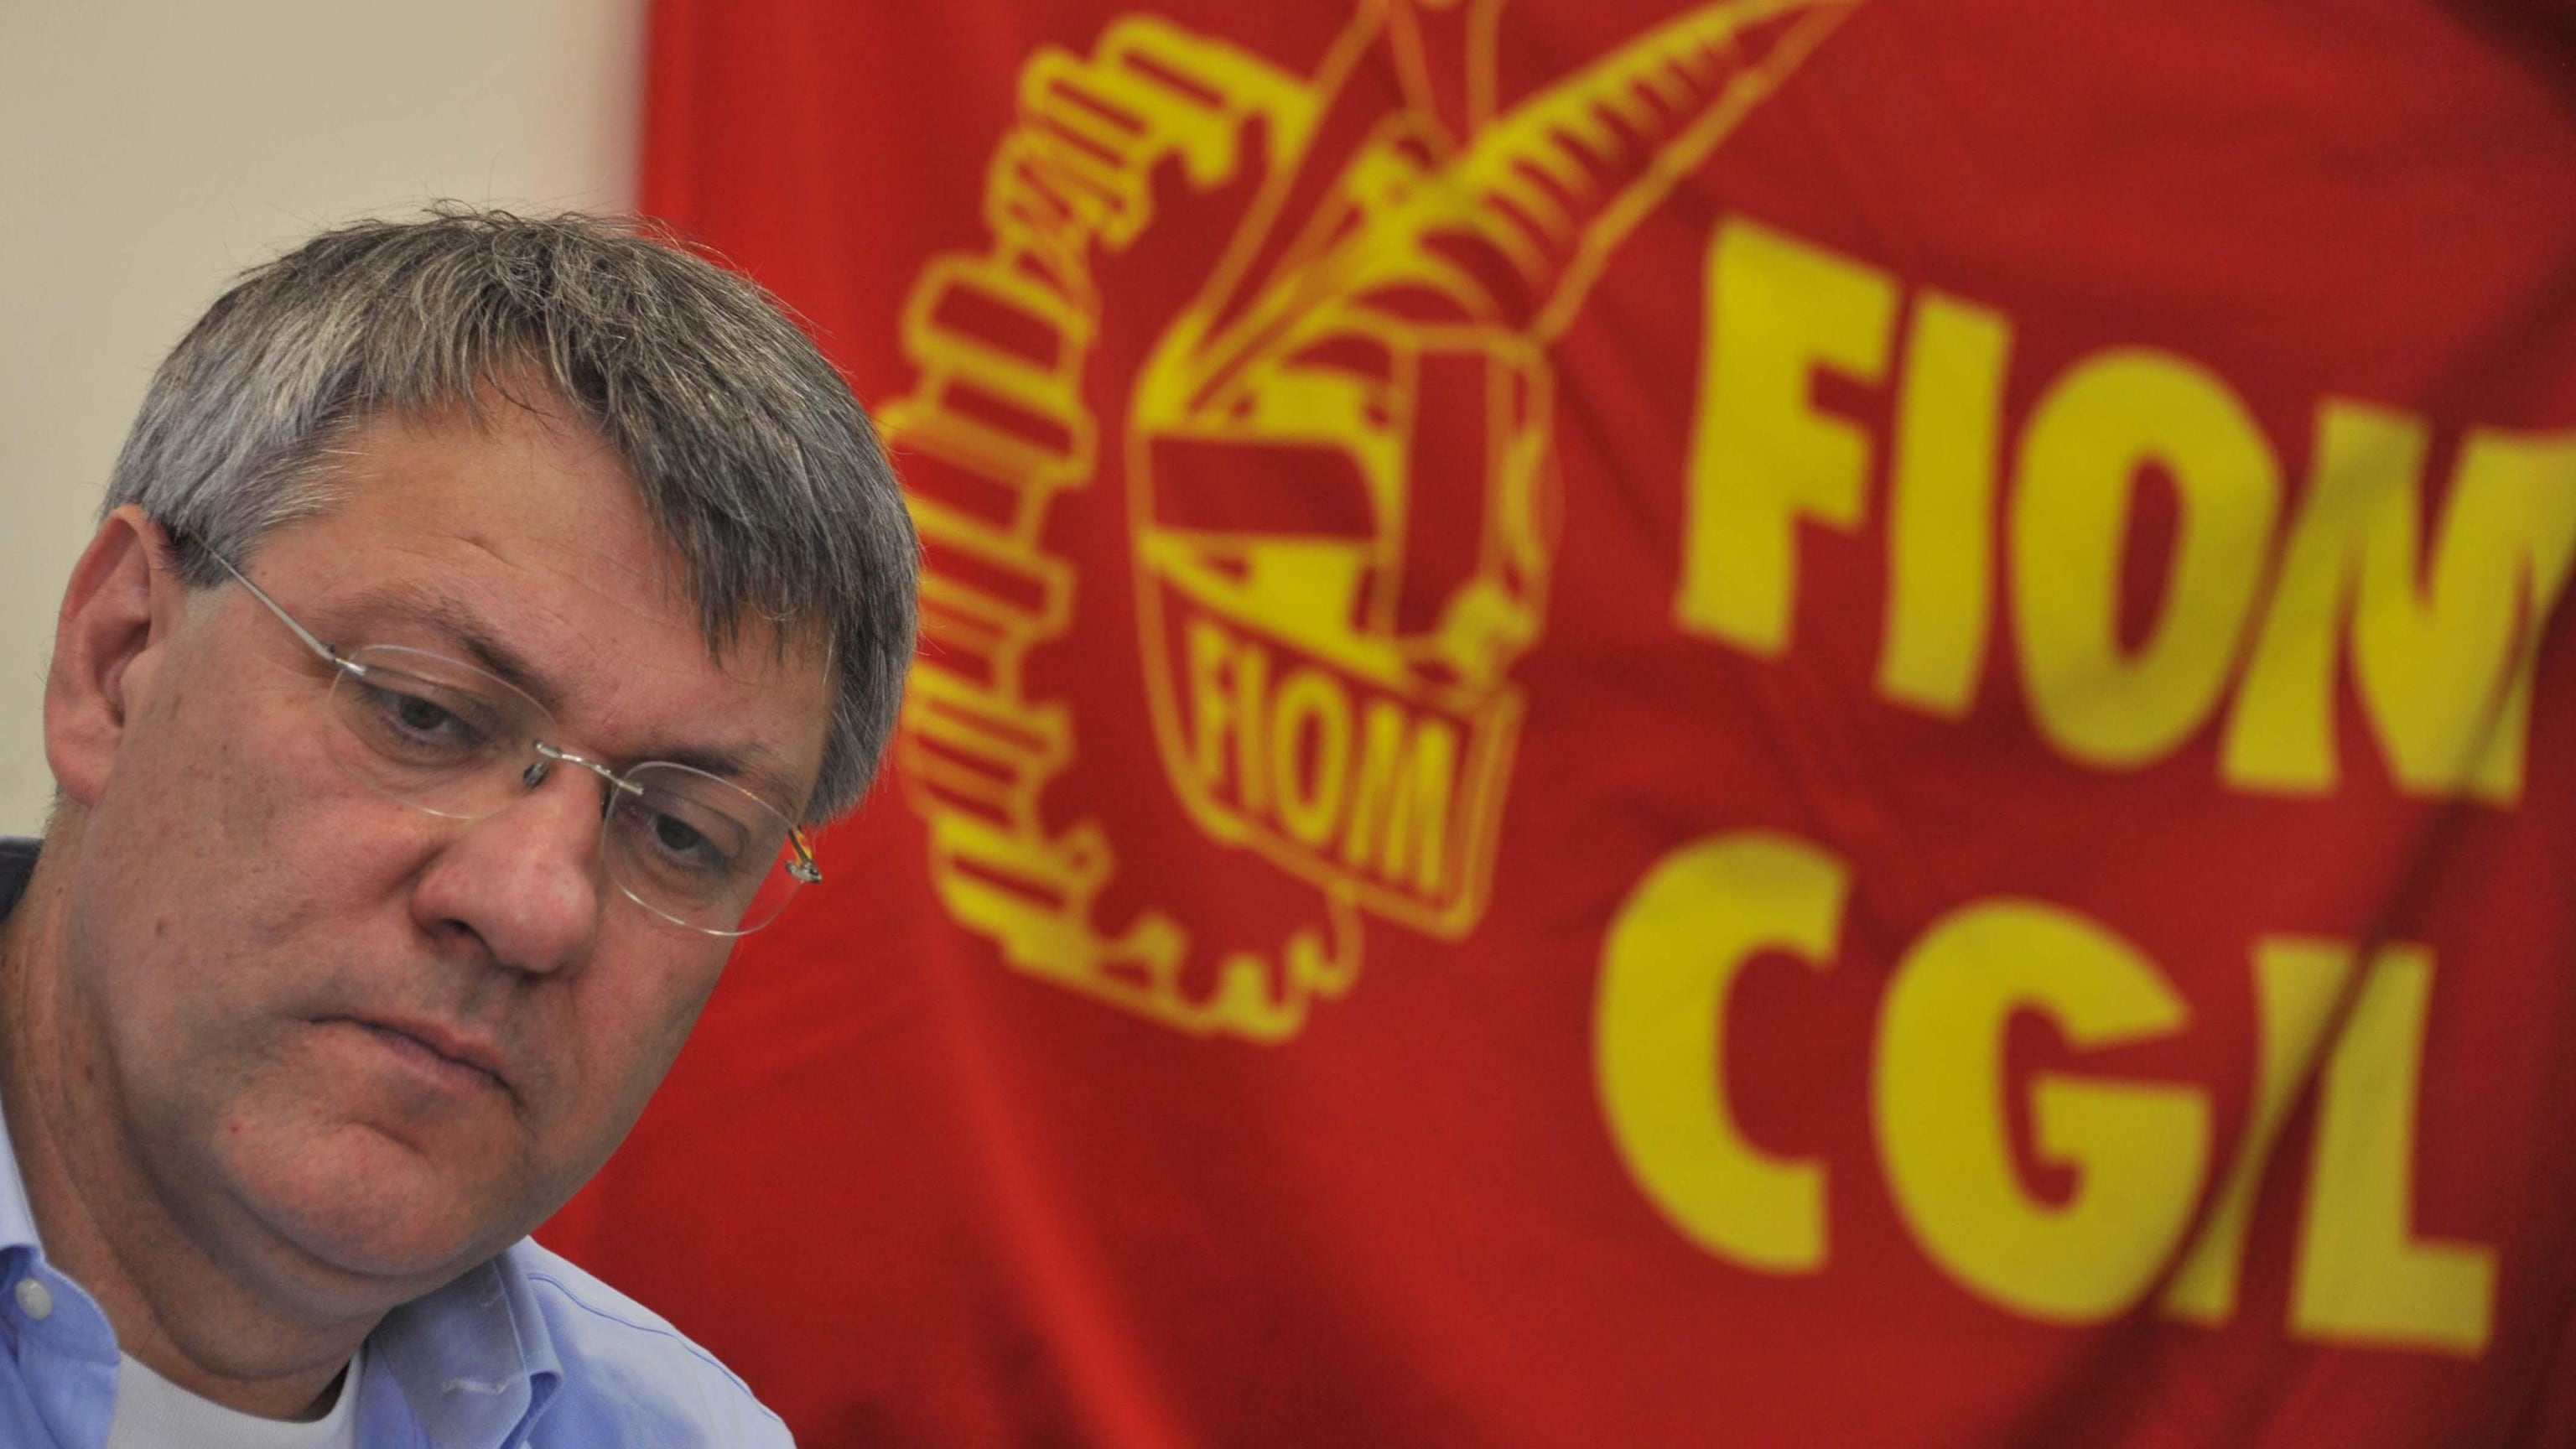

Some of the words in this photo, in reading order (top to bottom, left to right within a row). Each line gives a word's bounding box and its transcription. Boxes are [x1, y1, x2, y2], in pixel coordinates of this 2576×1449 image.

[1187, 622, 1452, 889] FIOM
[1679, 218, 2576, 800] FIOM
[1595, 833, 2494, 1352] CGIL
